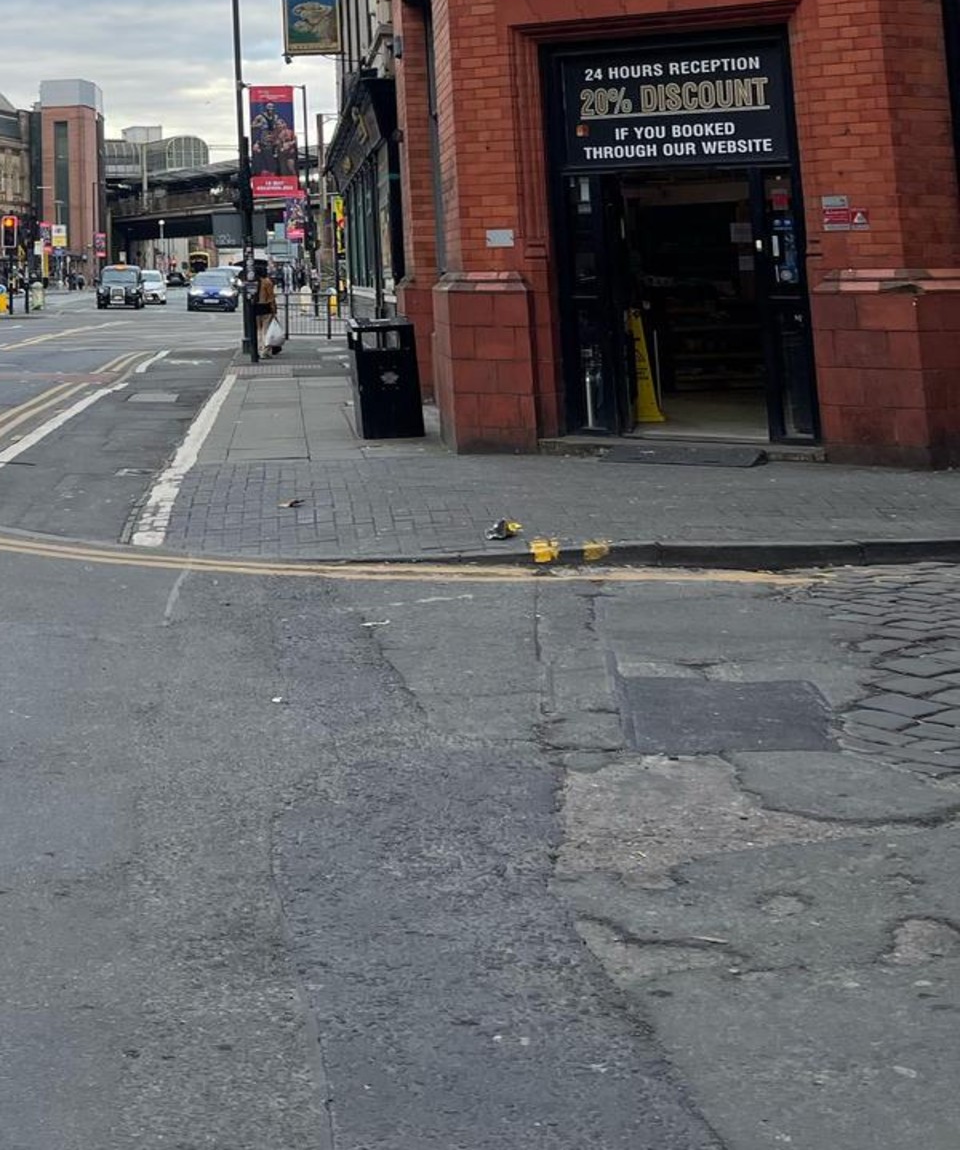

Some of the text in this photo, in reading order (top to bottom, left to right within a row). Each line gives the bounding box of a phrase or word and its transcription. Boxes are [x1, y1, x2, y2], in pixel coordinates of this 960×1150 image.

[584, 56, 761, 82] 24 HOURS RECEPTION
[580, 77, 769, 116] 20% DISCOUNT
[615, 121, 736, 141] IF YOU BOOKED
[583, 138, 773, 160] THROUGH OUR WEBSITE
